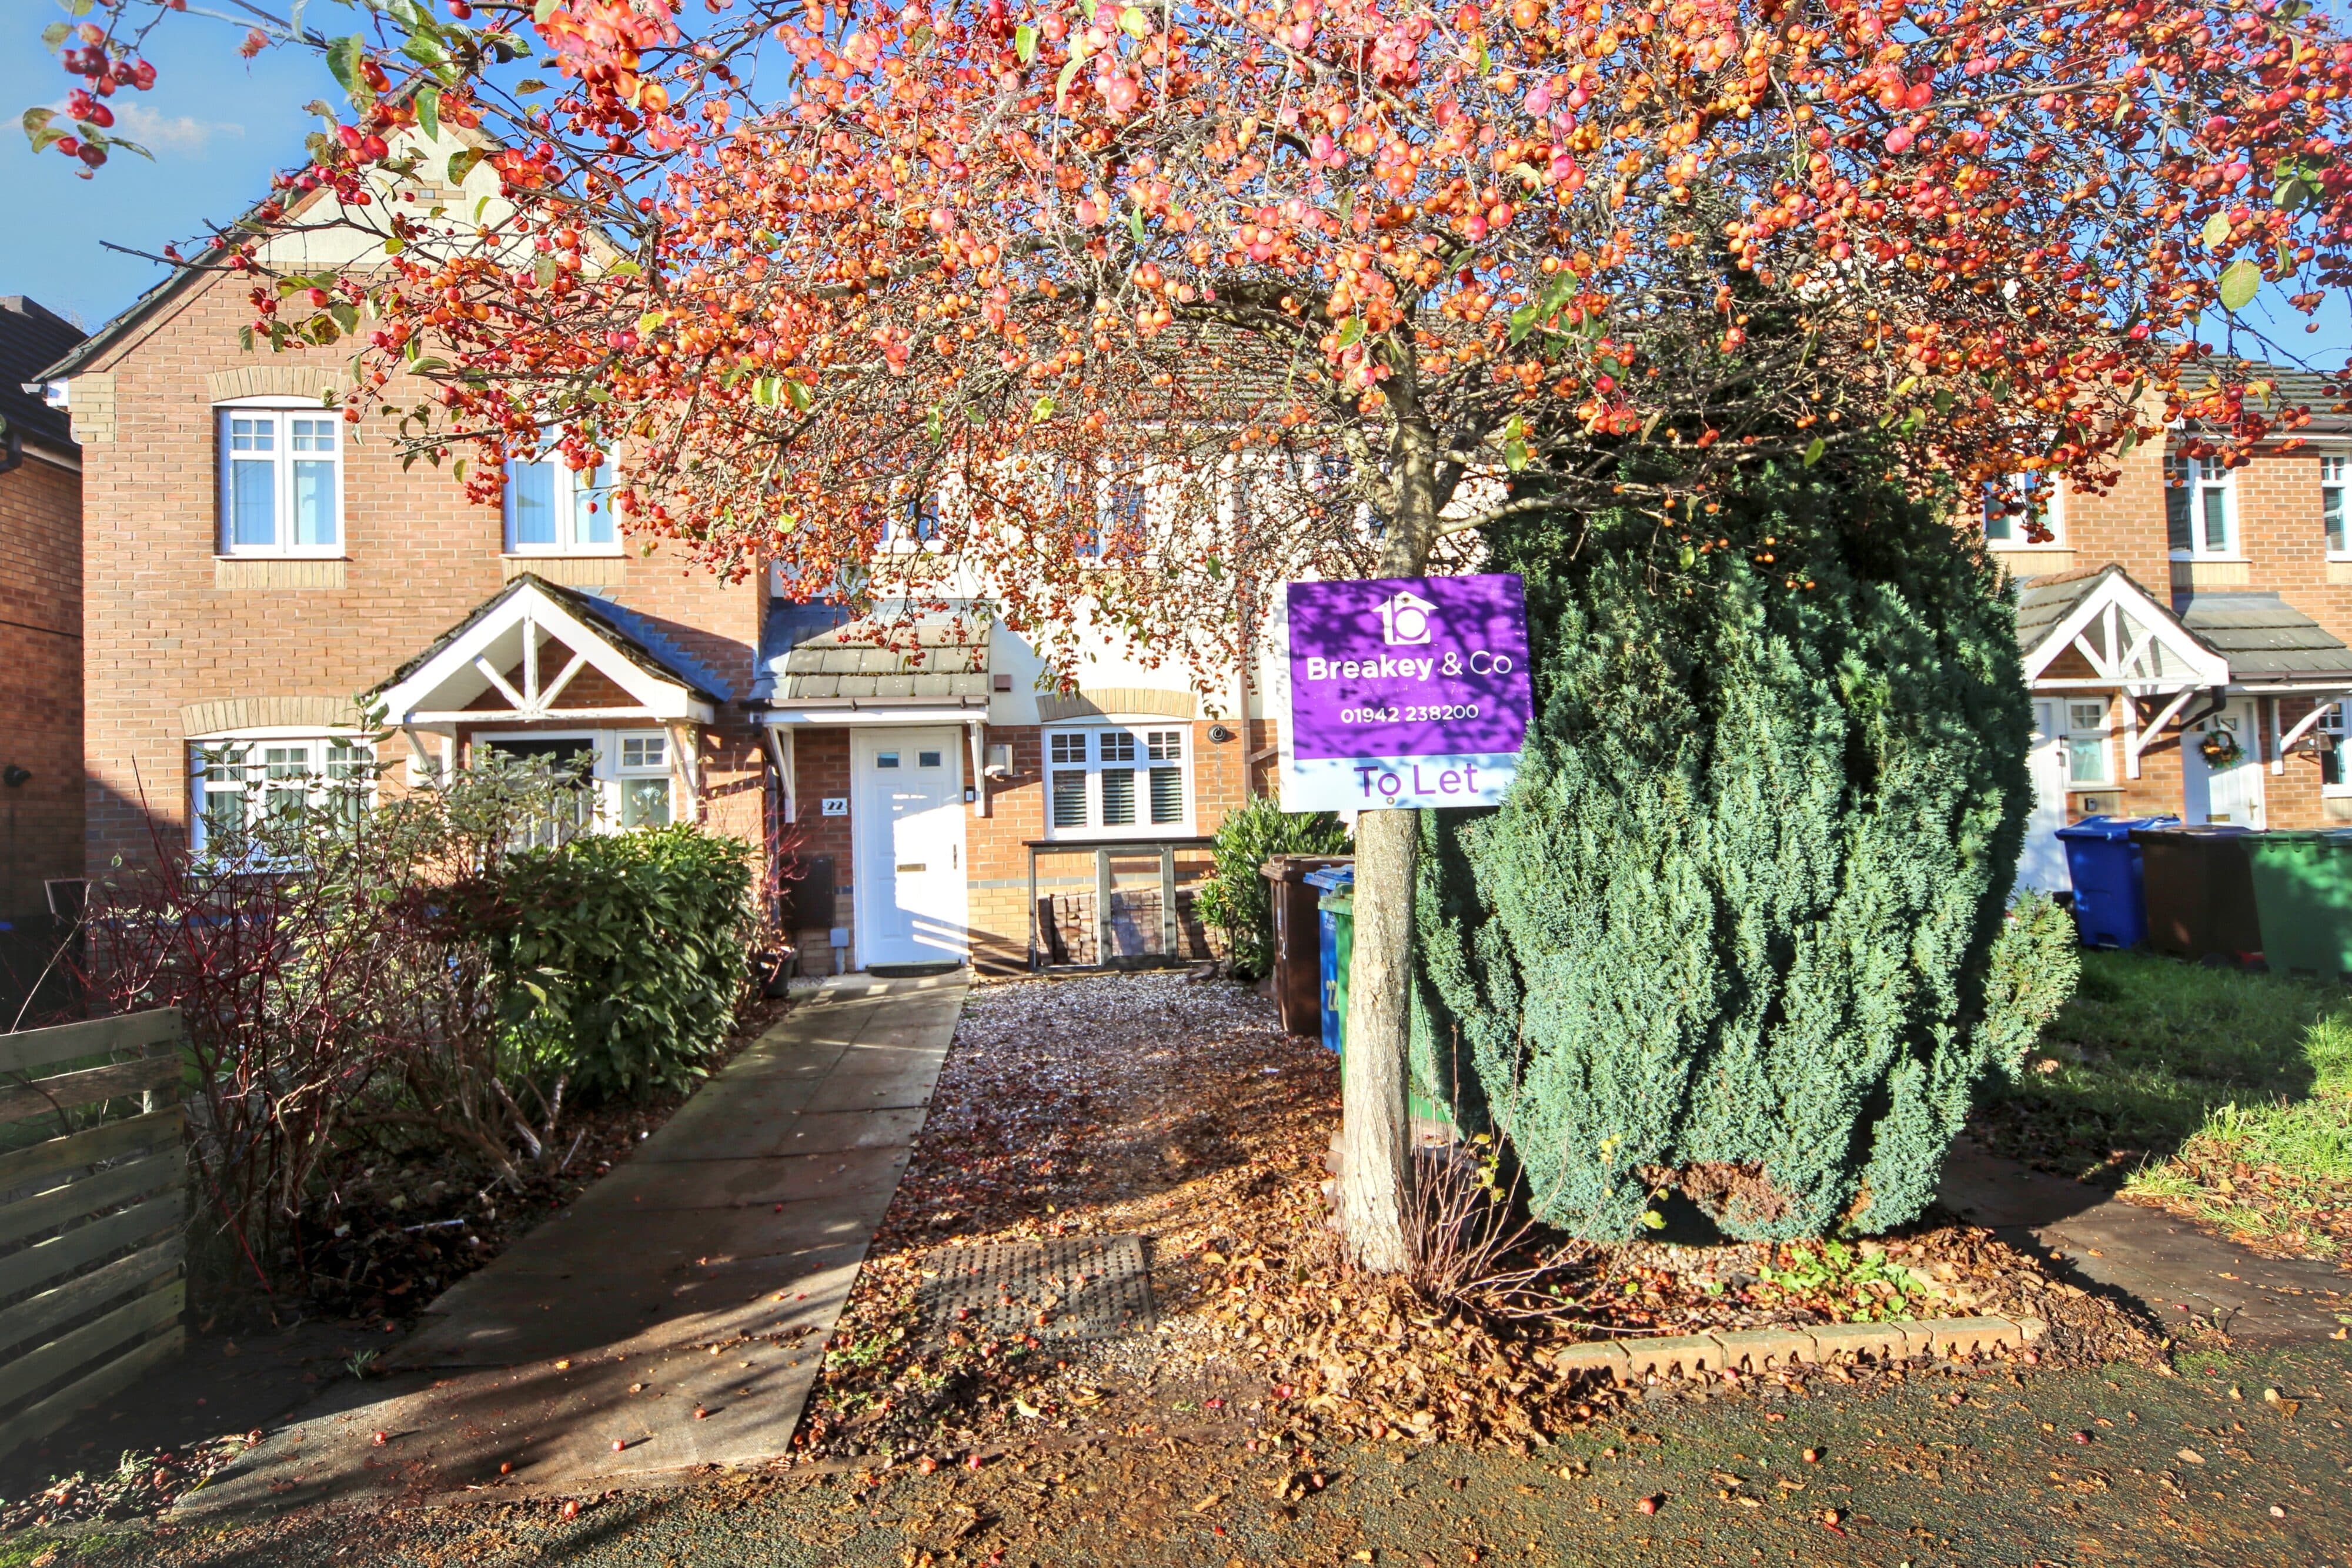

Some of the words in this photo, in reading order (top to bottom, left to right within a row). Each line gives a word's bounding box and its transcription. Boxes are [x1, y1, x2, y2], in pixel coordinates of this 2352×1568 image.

[1307, 653, 1434, 682] Breakey
[1442, 651, 1464, 676] &
[1470, 650, 1513, 675] Co
[1340, 707, 1400, 724] 01942
[1405, 704, 1479, 722] 238200
[1354, 765, 1402, 797] To
[1414, 763, 1479, 795] Let
[827, 800, 844, 810] 22
